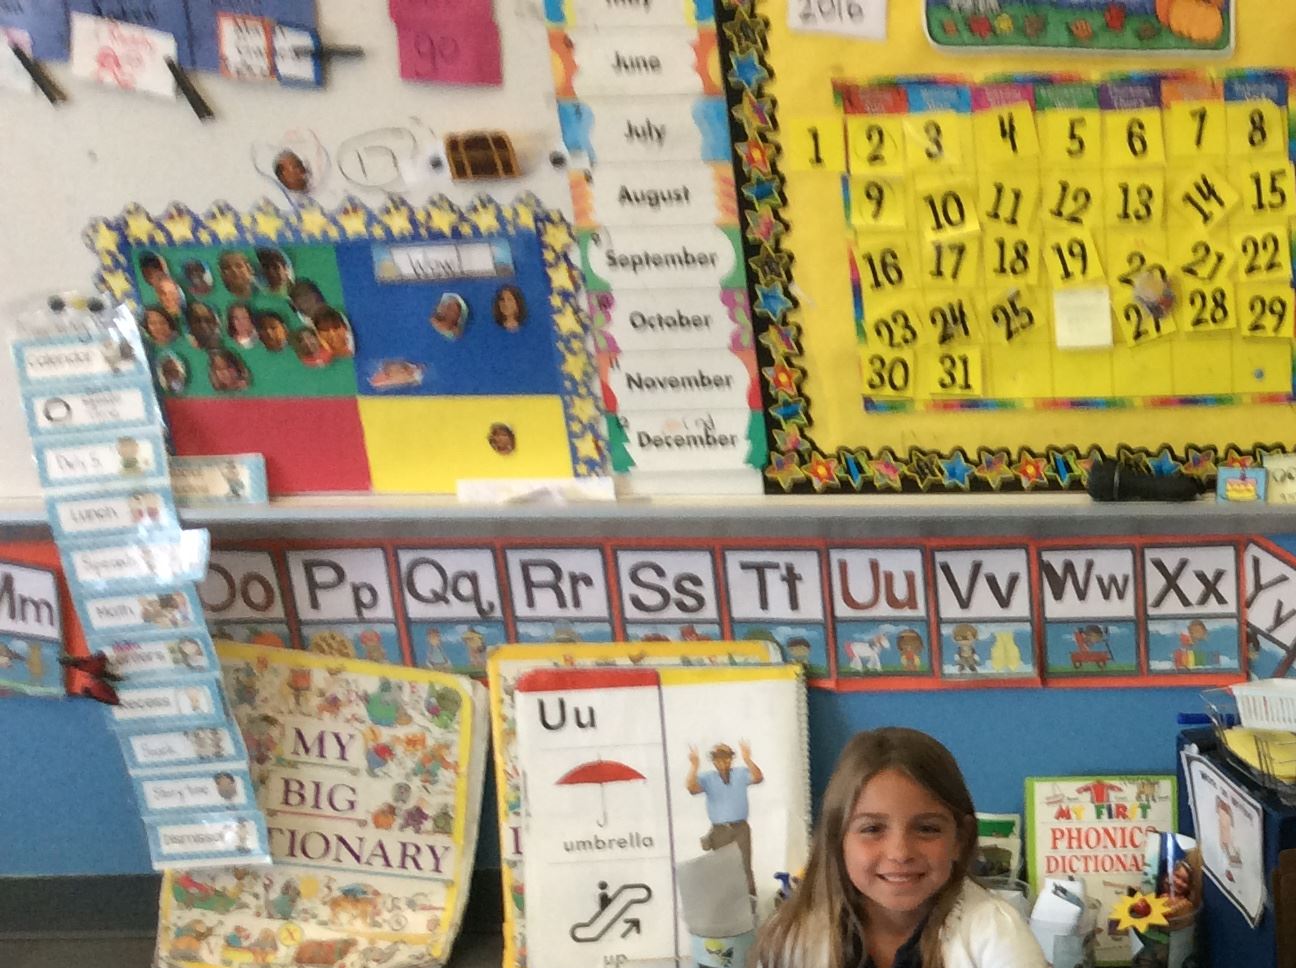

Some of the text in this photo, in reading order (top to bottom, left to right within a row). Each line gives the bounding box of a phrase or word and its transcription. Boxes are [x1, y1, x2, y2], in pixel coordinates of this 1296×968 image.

[611, 50, 663, 73] June
[623, 117, 667, 147] July
[808, 106, 1267, 166] 1 2 3 4 5 6 7 8
[617, 184, 692, 211] August
[864, 168, 1288, 231] 9 10 11 12 13 14 15
[606, 246, 719, 276] September
[862, 248, 904, 290] 16
[929, 240, 967, 280] 17
[993, 237, 1030, 276] 18
[1051, 237, 1088, 281] 19
[1180, 239, 1225, 281] 21
[1240, 231, 1284, 274] 22
[629, 309, 712, 331] October
[873, 309, 918, 348] 23
[929, 299, 970, 345] 24
[991, 290, 1035, 341] 25
[1189, 286, 1229, 329] 28
[1248, 294, 1289, 334] 29
[625, 368, 735, 391] November
[867, 352, 972, 391] 30 31
[636, 429, 739, 449] December
[202, 562, 275, 613] Oo
[302, 558, 379, 621] Pp
[405, 556, 495, 618] Qq
[520, 558, 594, 609] Rr
[628, 560, 706, 614] Ss
[738, 559, 803, 612] Tt
[837, 557, 919, 611] Uu
[938, 558, 1020, 610] Vv
[1042, 557, 1130, 602] Ww
[1149, 556, 1228, 609] Xx
[537, 698, 597, 732] Uu
[290, 727, 355, 762] MY
[281, 776, 357, 813] BIG
[1054, 802, 1151, 821] MY FIRST
[563, 832, 654, 853] umbrella
[1050, 825, 1158, 851] PHONIC
[1044, 852, 1146, 875] DICTIONA
[603, 953, 628, 968] up
